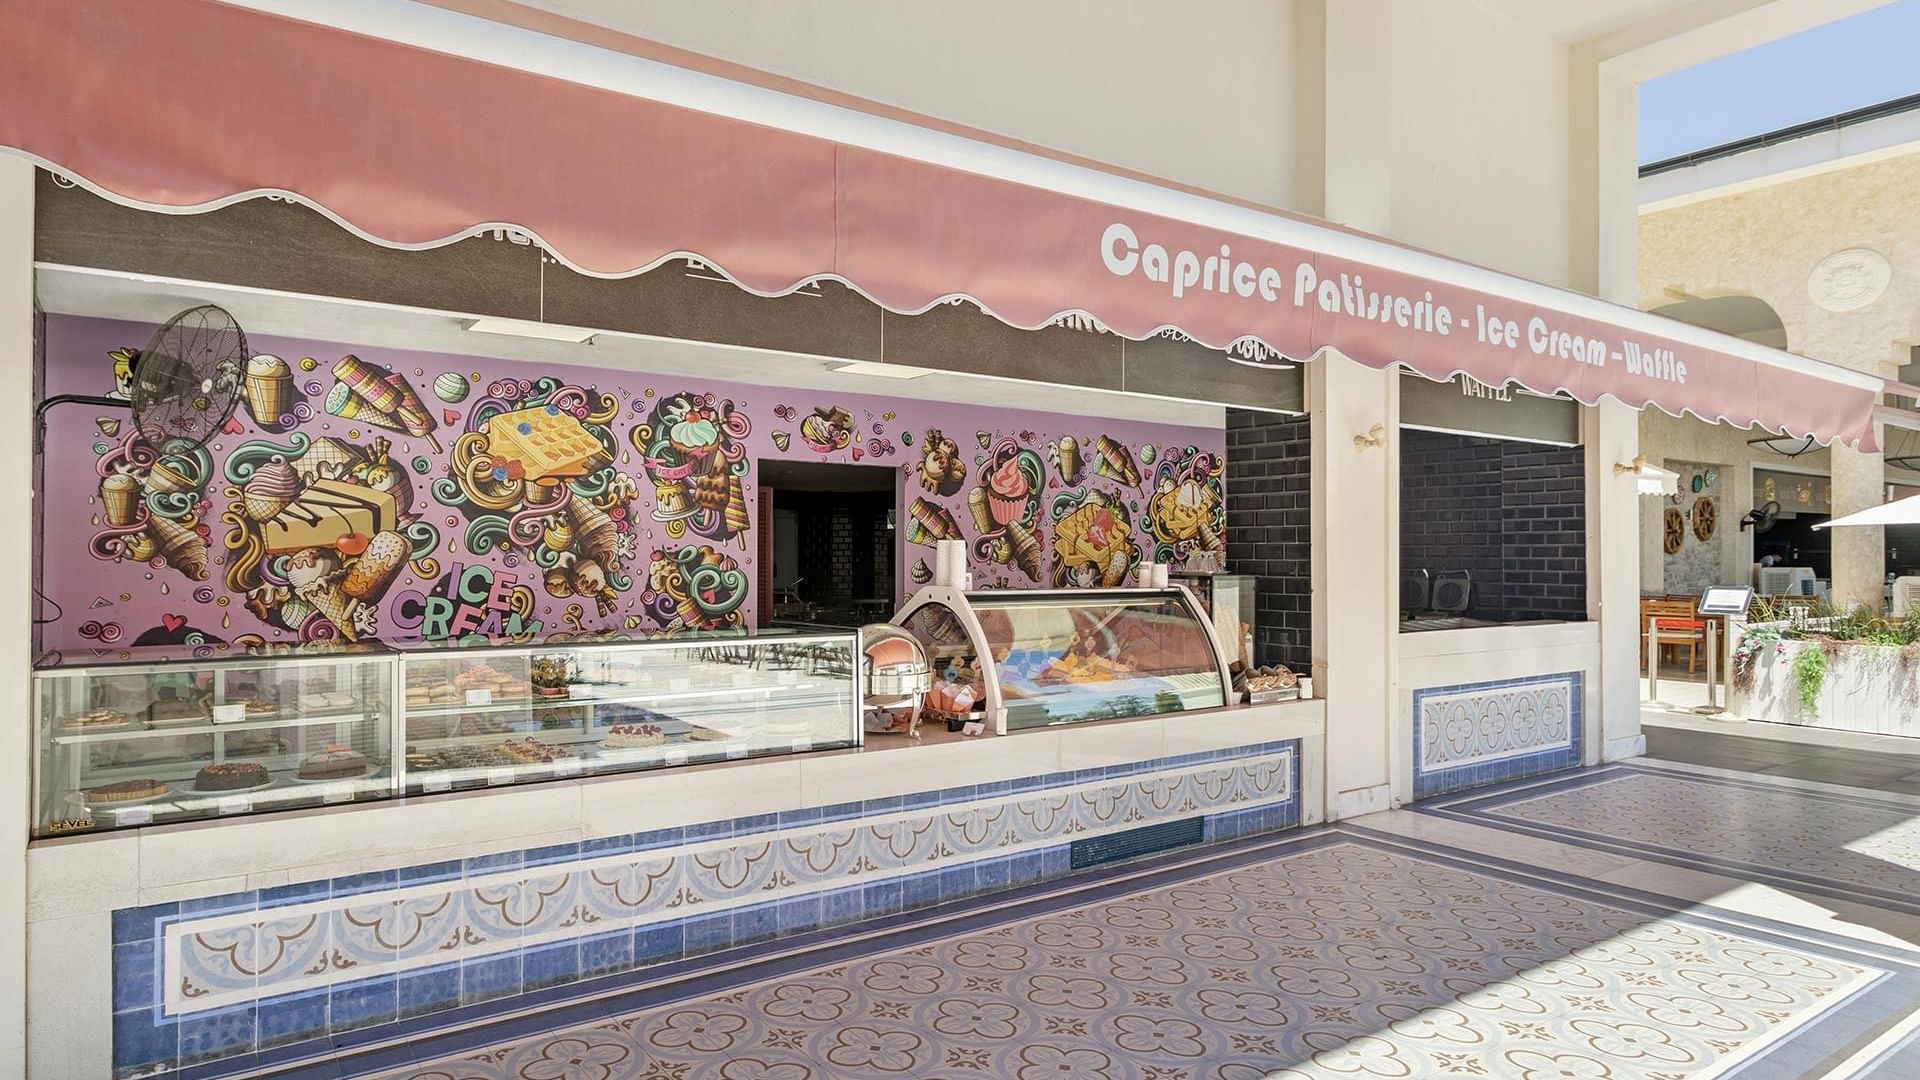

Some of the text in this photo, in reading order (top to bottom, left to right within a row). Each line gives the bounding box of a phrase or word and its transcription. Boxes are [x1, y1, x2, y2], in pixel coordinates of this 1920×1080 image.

[1101, 223, 1282, 302] Caprice
[1294, 262, 1452, 335] Patisserie
[1476, 304, 1520, 349] Ice
[1527, 317, 1607, 367] Cream
[447, 561, 518, 612] ICE
[390, 589, 545, 641] CREAM
